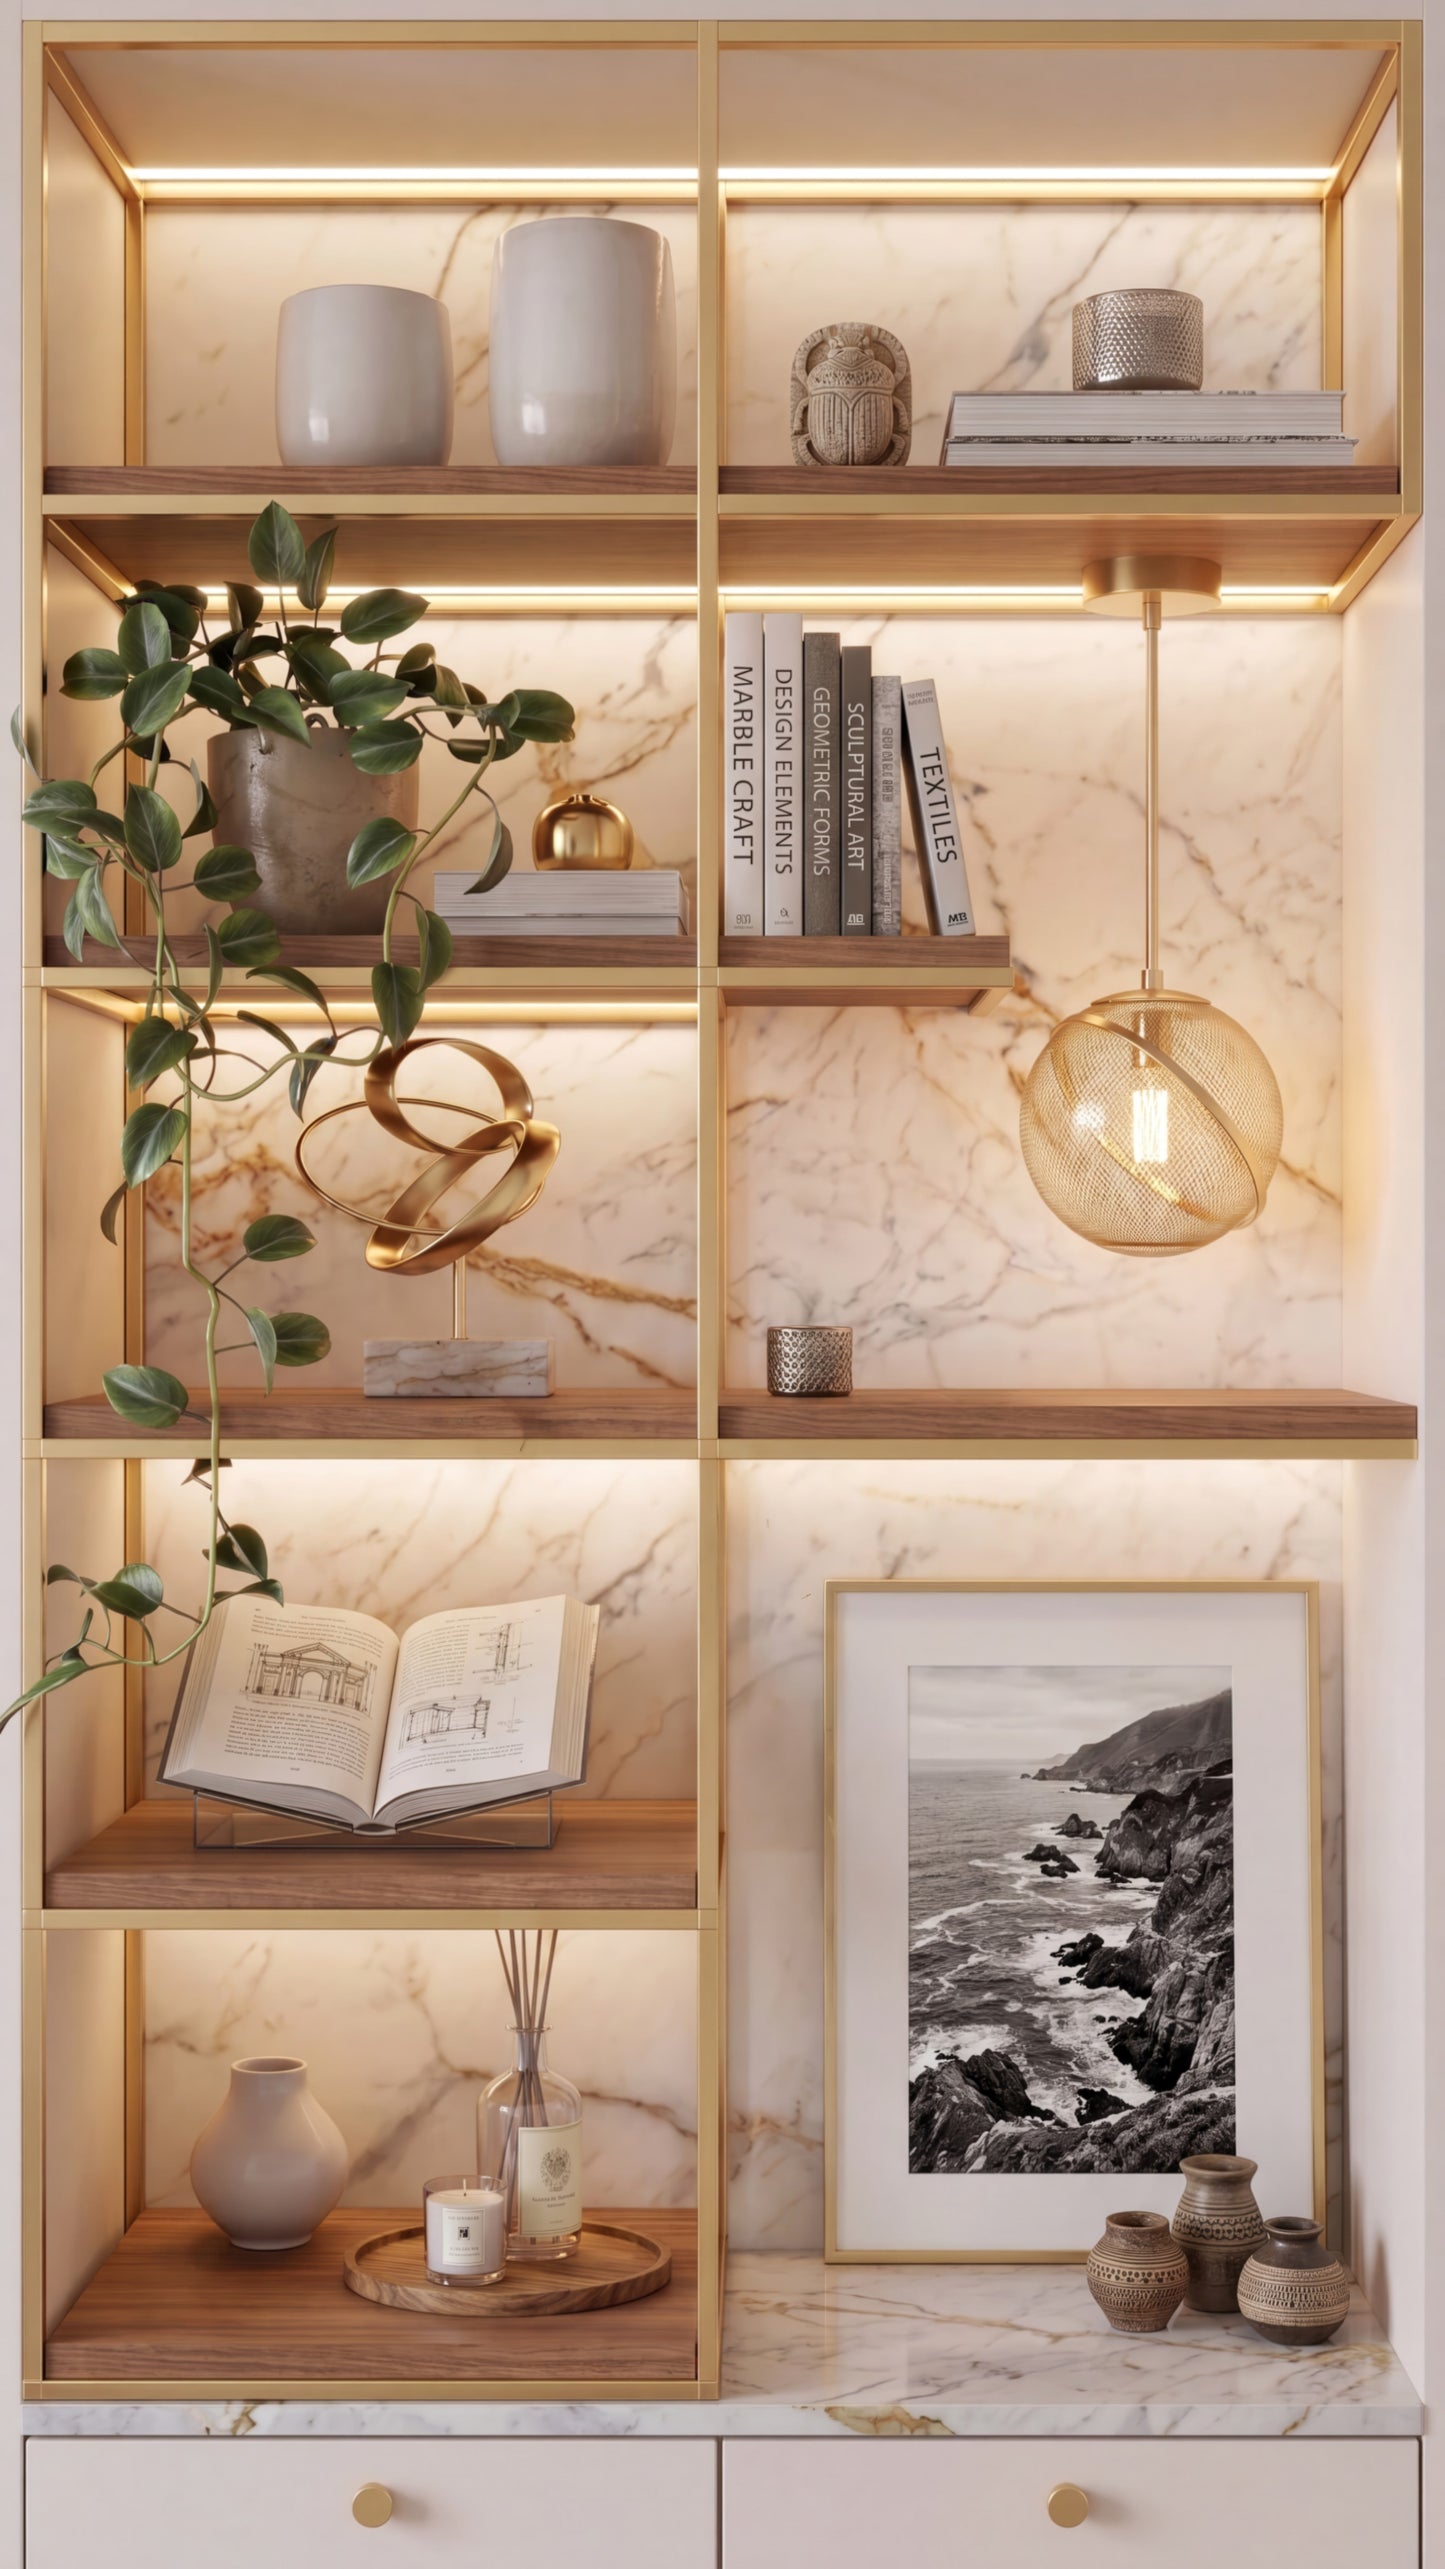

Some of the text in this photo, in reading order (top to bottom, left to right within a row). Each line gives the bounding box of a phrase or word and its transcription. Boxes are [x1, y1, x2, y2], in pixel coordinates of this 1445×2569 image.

[733, 666, 754, 865] MARBLE CRAFT
[775, 669, 793, 874] DESIGN ELEMENTS
[813, 687, 831, 876] GEOMETRIC FORMS
[847, 702, 865, 871] SCULPTURAL ART
[920, 747, 957, 863] TEXTILES
